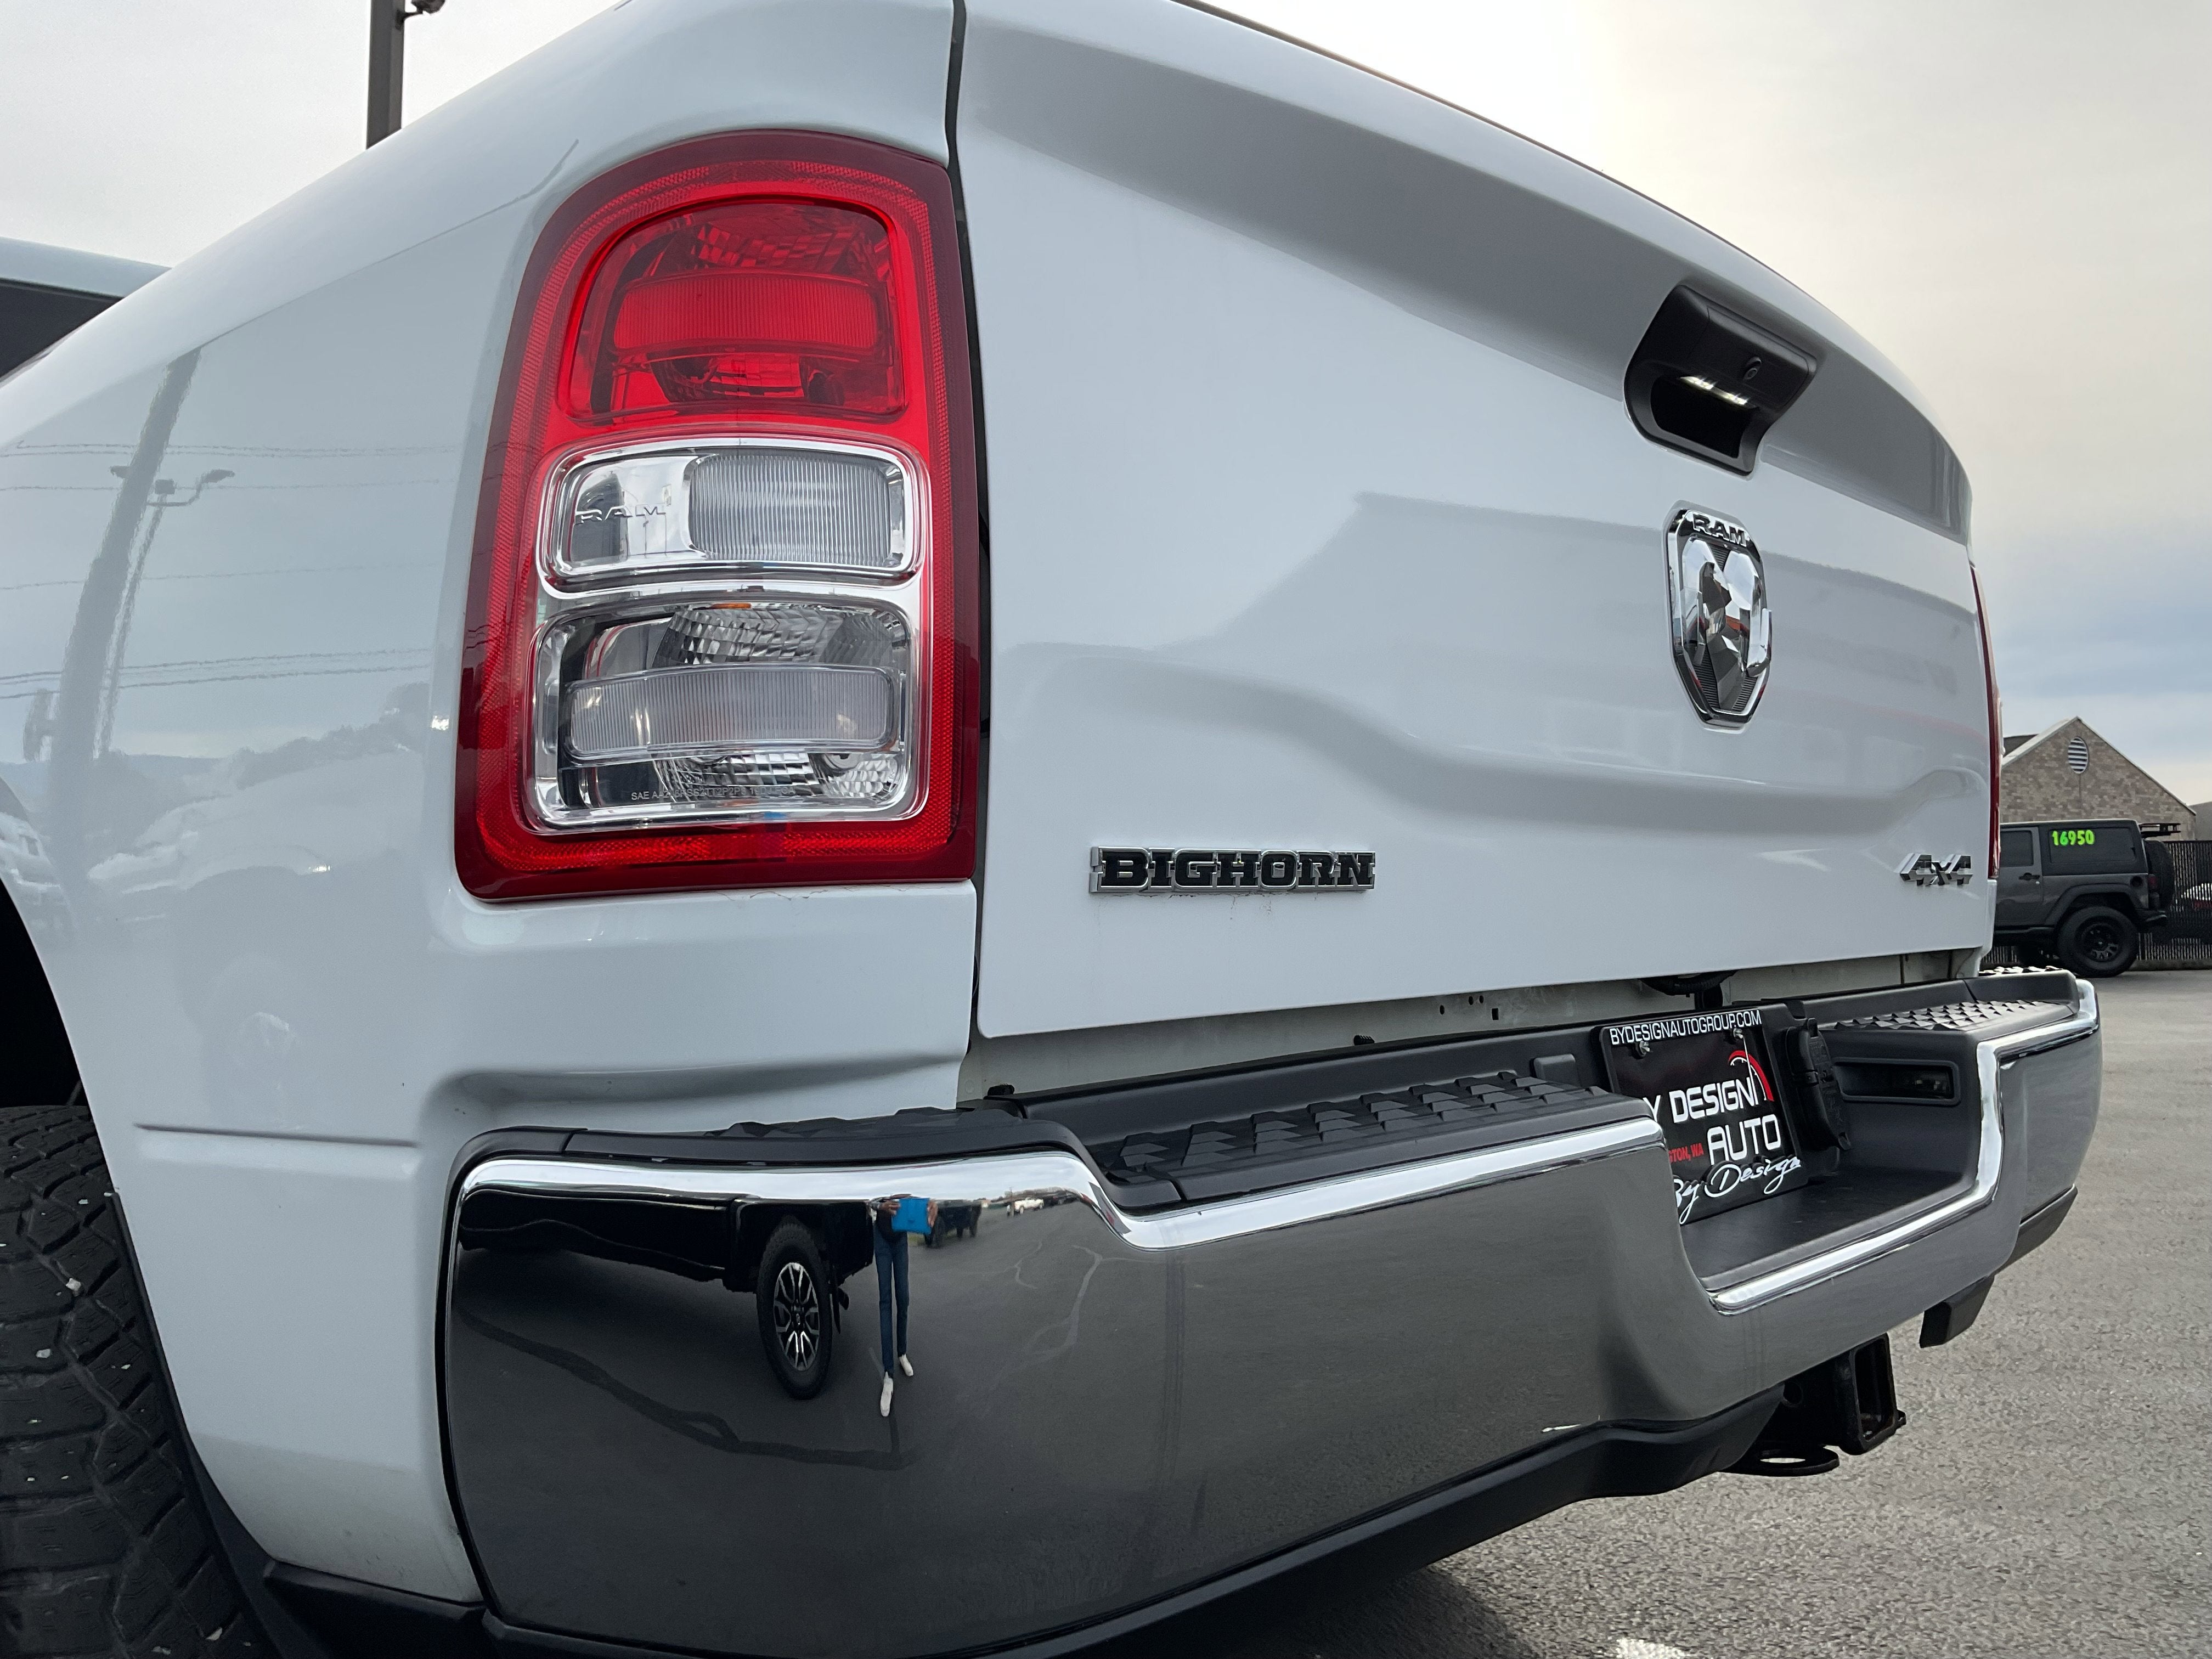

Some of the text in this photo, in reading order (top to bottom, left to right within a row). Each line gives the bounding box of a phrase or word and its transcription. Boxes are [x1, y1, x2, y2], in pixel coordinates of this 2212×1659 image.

[1692, 512, 1747, 548] RAM
[631, 790, 650, 800] SAE
[2052, 830, 2095, 846] 16950
[1089, 847, 1376, 893] BIGHORN
[1610, 1009, 1762, 1045] BYDESIGNAUTOGROUP.COM
[1669, 1077, 1759, 1123] DESIGN
[1690, 1143, 1703, 1158] WA
[1707, 1114, 1781, 1165] AUTO
[1704, 1155, 1802, 1198] Design
